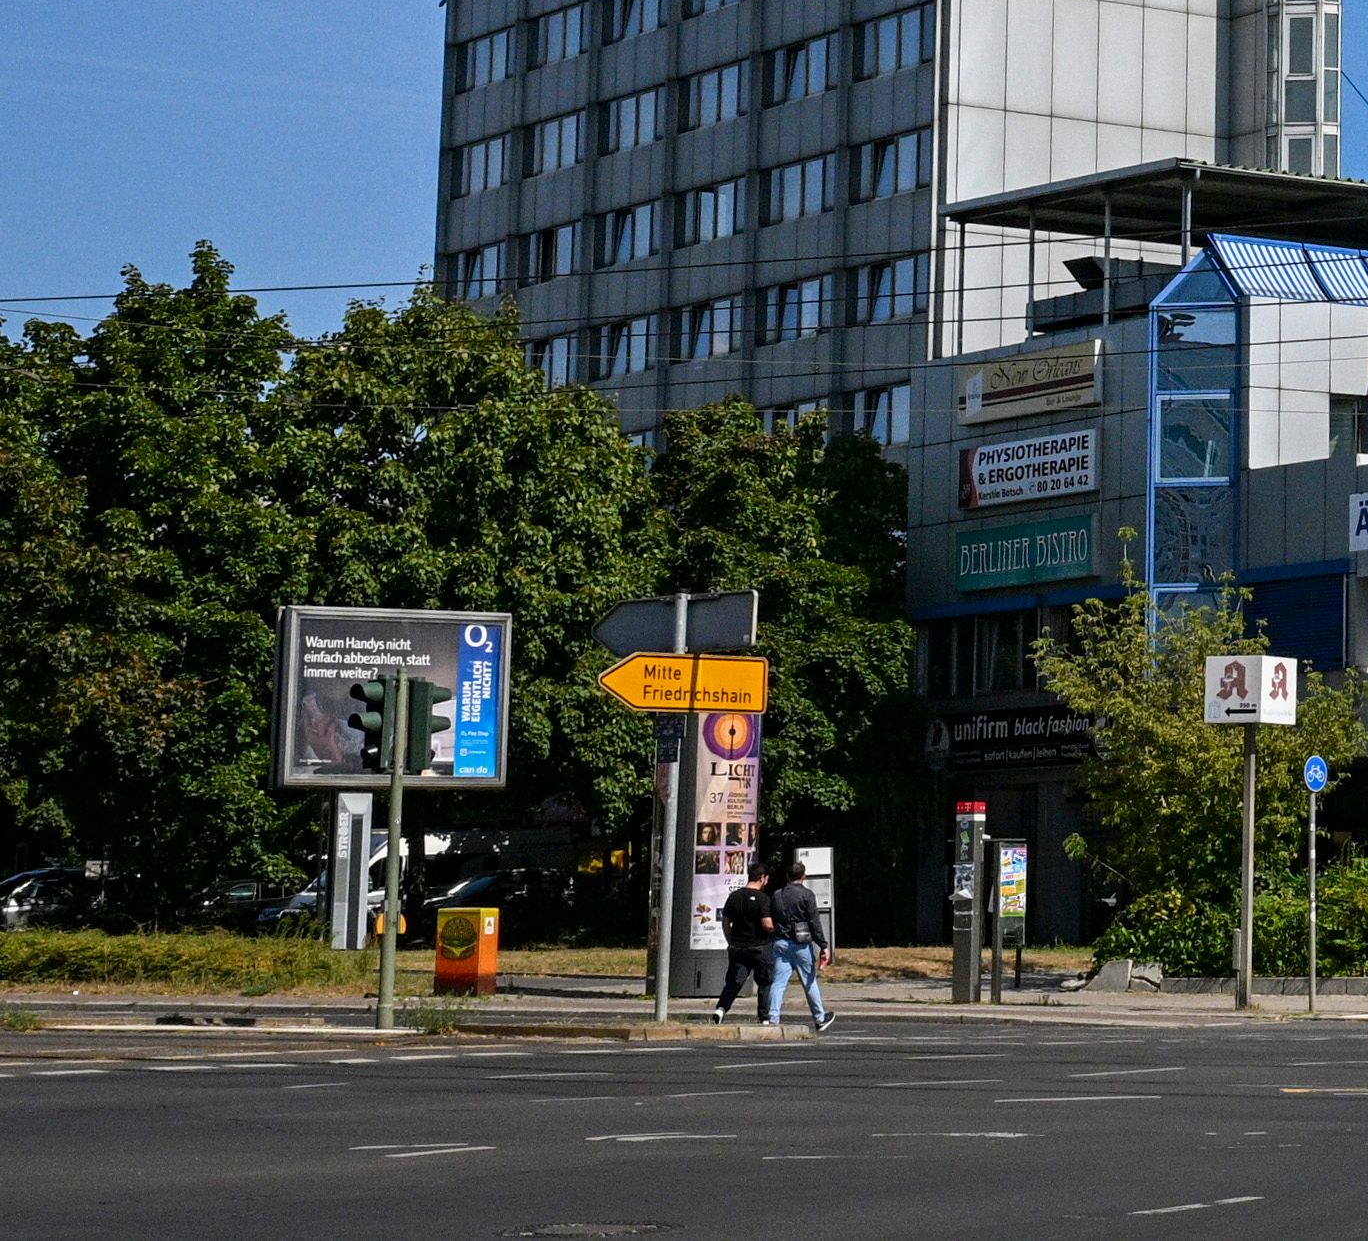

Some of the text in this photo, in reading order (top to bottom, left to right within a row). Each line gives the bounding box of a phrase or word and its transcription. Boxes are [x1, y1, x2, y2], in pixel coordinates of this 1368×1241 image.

[990, 356, 1083, 389] New Orleans
[978, 435, 1089, 466] PHYSIOTHERAPIE
[978, 455, 1089, 485] & ERGOTHERAPIE
[978, 489, 1000, 501] Kerstin
[1037, 480, 1048, 493] 80
[1051, 478, 1061, 490] 20
[1064, 476, 1075, 489] 64
[1078, 474, 1089, 486] 42
[960, 529, 1088, 576] BERLINER BISTRO
[305, 636, 411, 652] Warum Handys nicht
[304, 651, 430, 666] einfach abbezahlen, statt
[644, 664, 681, 680] Mitte
[304, 666, 378, 679] immer weiter?
[482, 661, 493, 699] NICHT?
[461, 680, 471, 723] WARUM
[471, 660, 483, 723] EIGENTLICH
[643, 685, 751, 703] Friedrichshain
[954, 715, 1008, 741] unifirm
[1014, 716, 1045, 736] black
[1046, 714, 1090, 737] fashion
[459, 765, 488, 774] can do
[711, 762, 756, 776] LICHT
